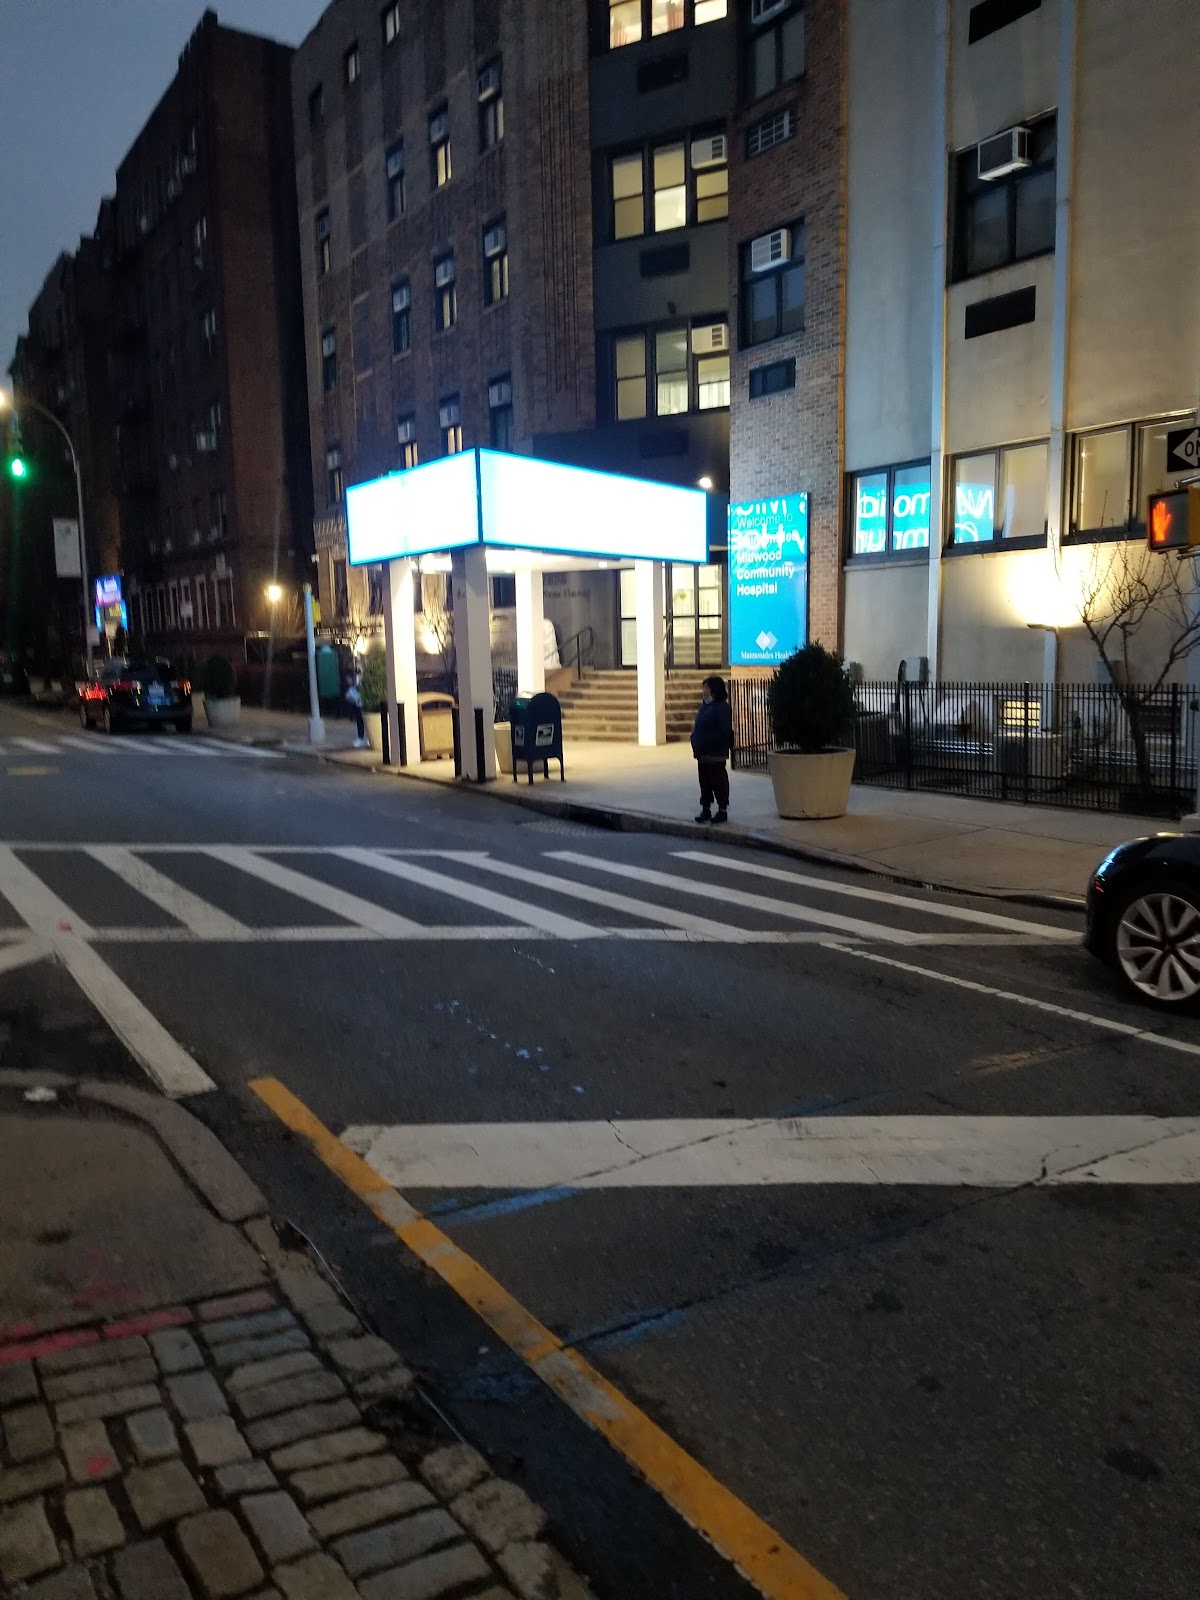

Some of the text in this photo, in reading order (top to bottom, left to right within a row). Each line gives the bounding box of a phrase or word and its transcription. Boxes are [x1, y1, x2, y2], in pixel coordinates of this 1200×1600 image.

[737, 515, 781, 529] Welcome
[737, 549, 782, 564] Midwood
[736, 564, 795, 580] Community
[737, 582, 778, 597] Hospital
